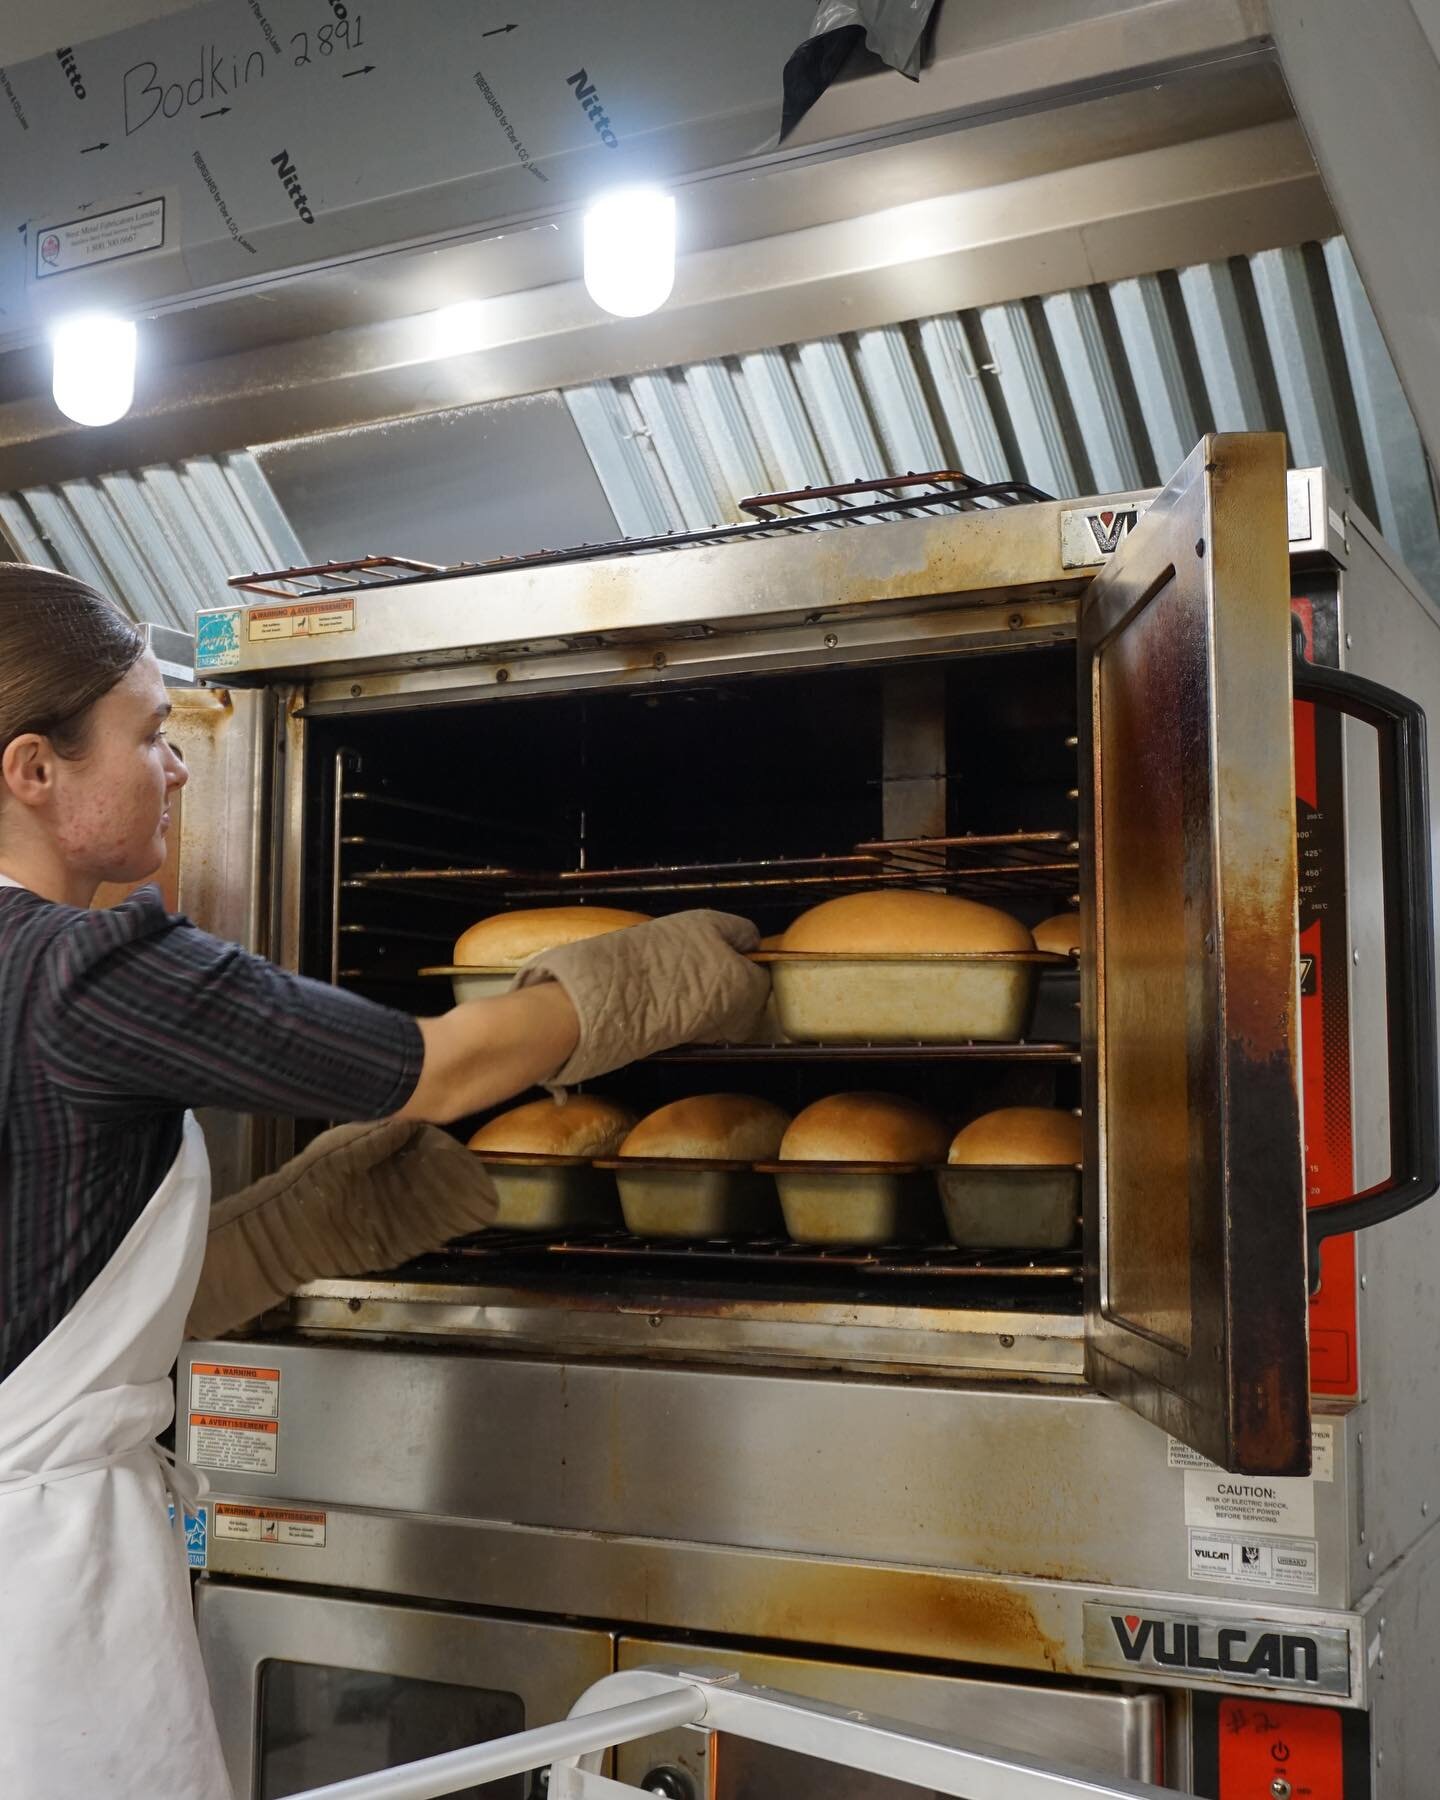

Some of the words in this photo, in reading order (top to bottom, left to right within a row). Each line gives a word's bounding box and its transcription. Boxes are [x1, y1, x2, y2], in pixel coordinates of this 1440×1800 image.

[123, 45, 265, 136] Bodkin
[290, 15, 364, 66] 2891
[473, 72, 504, 118] FIBERGUARD
[499, 116, 509, 127] for
[504, 125, 519, 145] Fiber
[566, 67, 618, 149] Nitto
[192, 151, 218, 194] FIBERGUARD
[270, 149, 314, 224] Nitto
[222, 1367, 257, 1378] WARNING
[208, 1418, 269, 1431] AVERTISSEMENT
[1217, 1484, 1276, 1499] CAUTION:
[1232, 1498, 1263, 1507] ELECTRIC
[223, 1506, 256, 1517] WARNING
[1214, 1504, 1255, 1514] DISCONNECT
[1256, 1508, 1280, 1516] POWER
[1216, 1512, 1241, 1520] BEFORE
[1194, 1549, 1230, 1560] VULCAN
[1111, 1615, 1318, 1682] VULCAN
